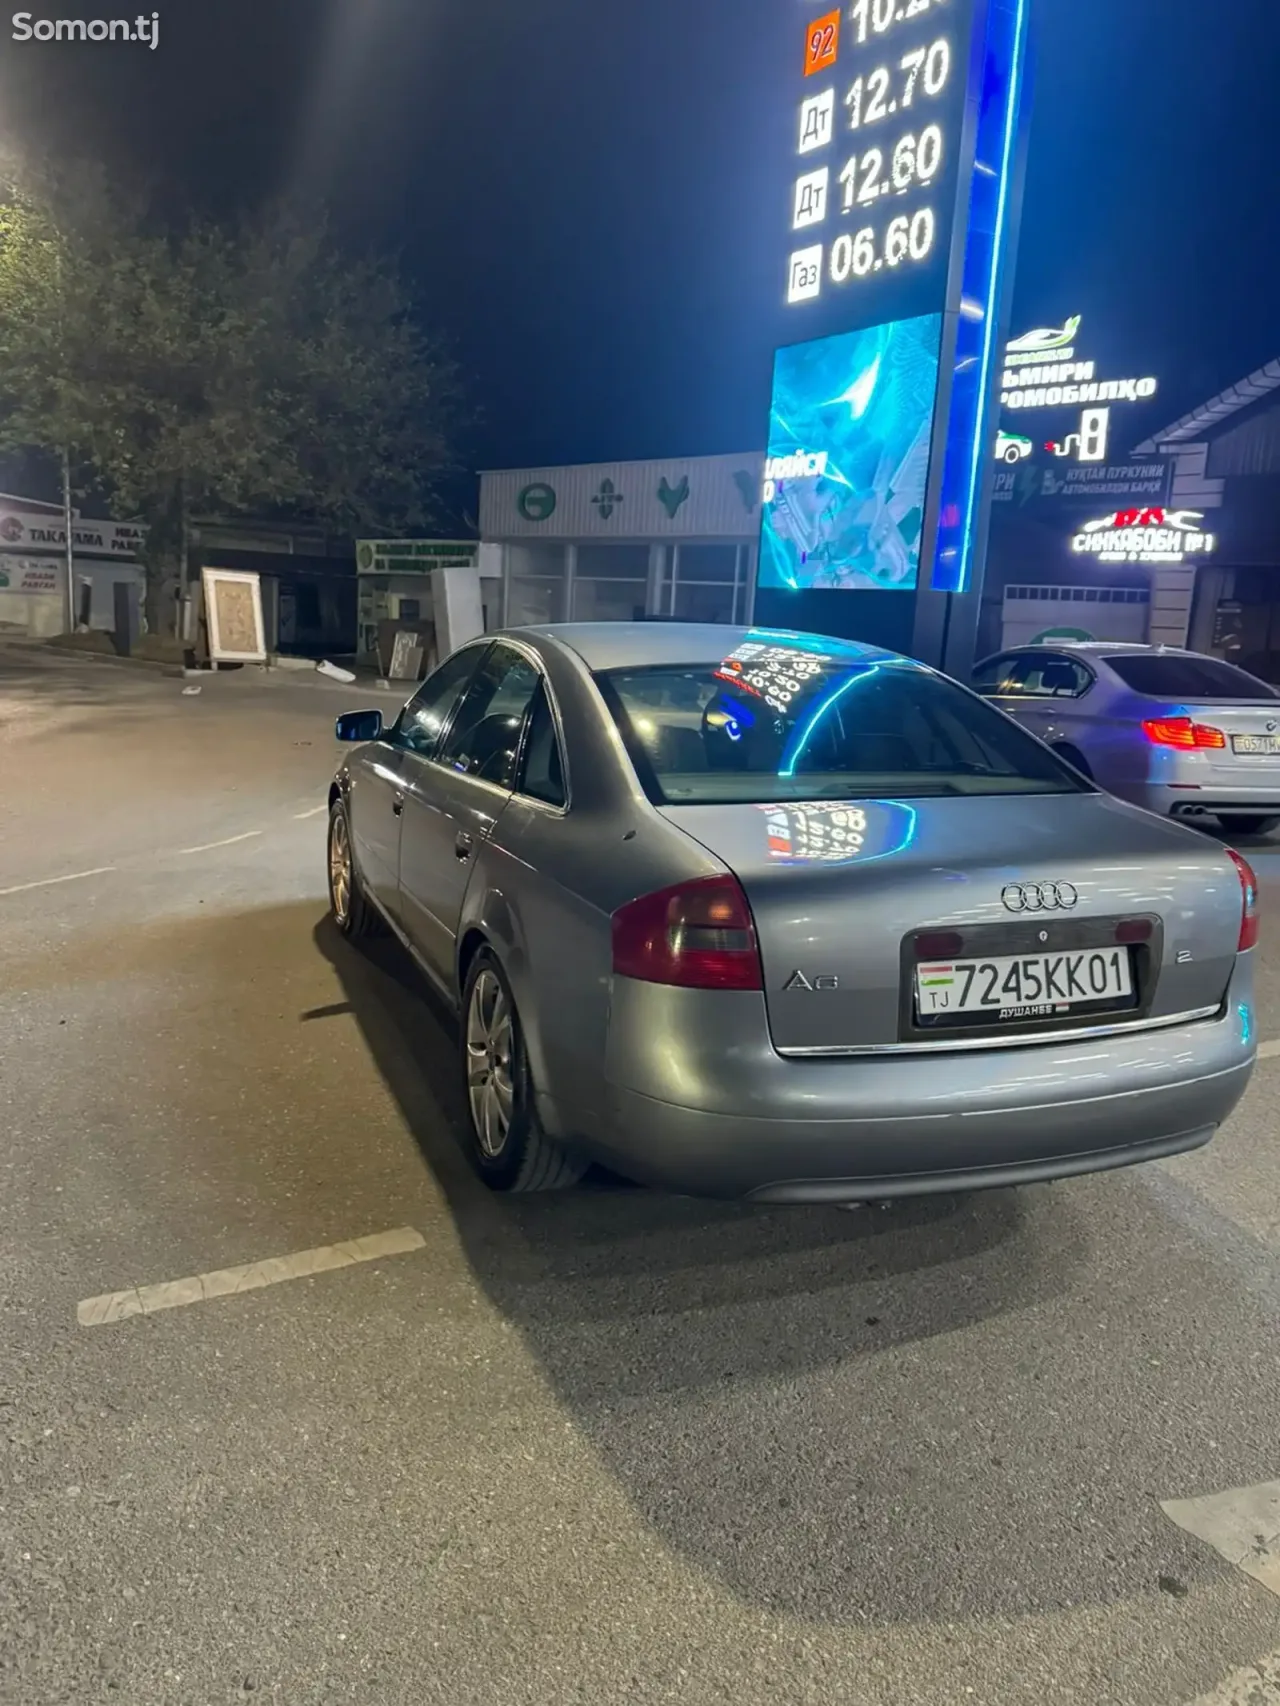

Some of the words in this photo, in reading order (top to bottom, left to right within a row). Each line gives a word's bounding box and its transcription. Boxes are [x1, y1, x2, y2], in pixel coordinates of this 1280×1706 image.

[810, 24, 835, 63] 92
[852, 0, 948, 43] 10.2
[802, 104, 829, 146] Дт
[845, 40, 949, 129] 12.70
[797, 186, 823, 222] Дт
[839, 124, 941, 209] 12.60
[791, 259, 818, 289] Газ
[829, 207, 934, 281] 06.60
[782, 969, 838, 992] A6
[930, 991, 949, 1009] TJ
[955, 952, 1122, 1008] 7245KK01
[1176, 949, 1193, 964] 2
